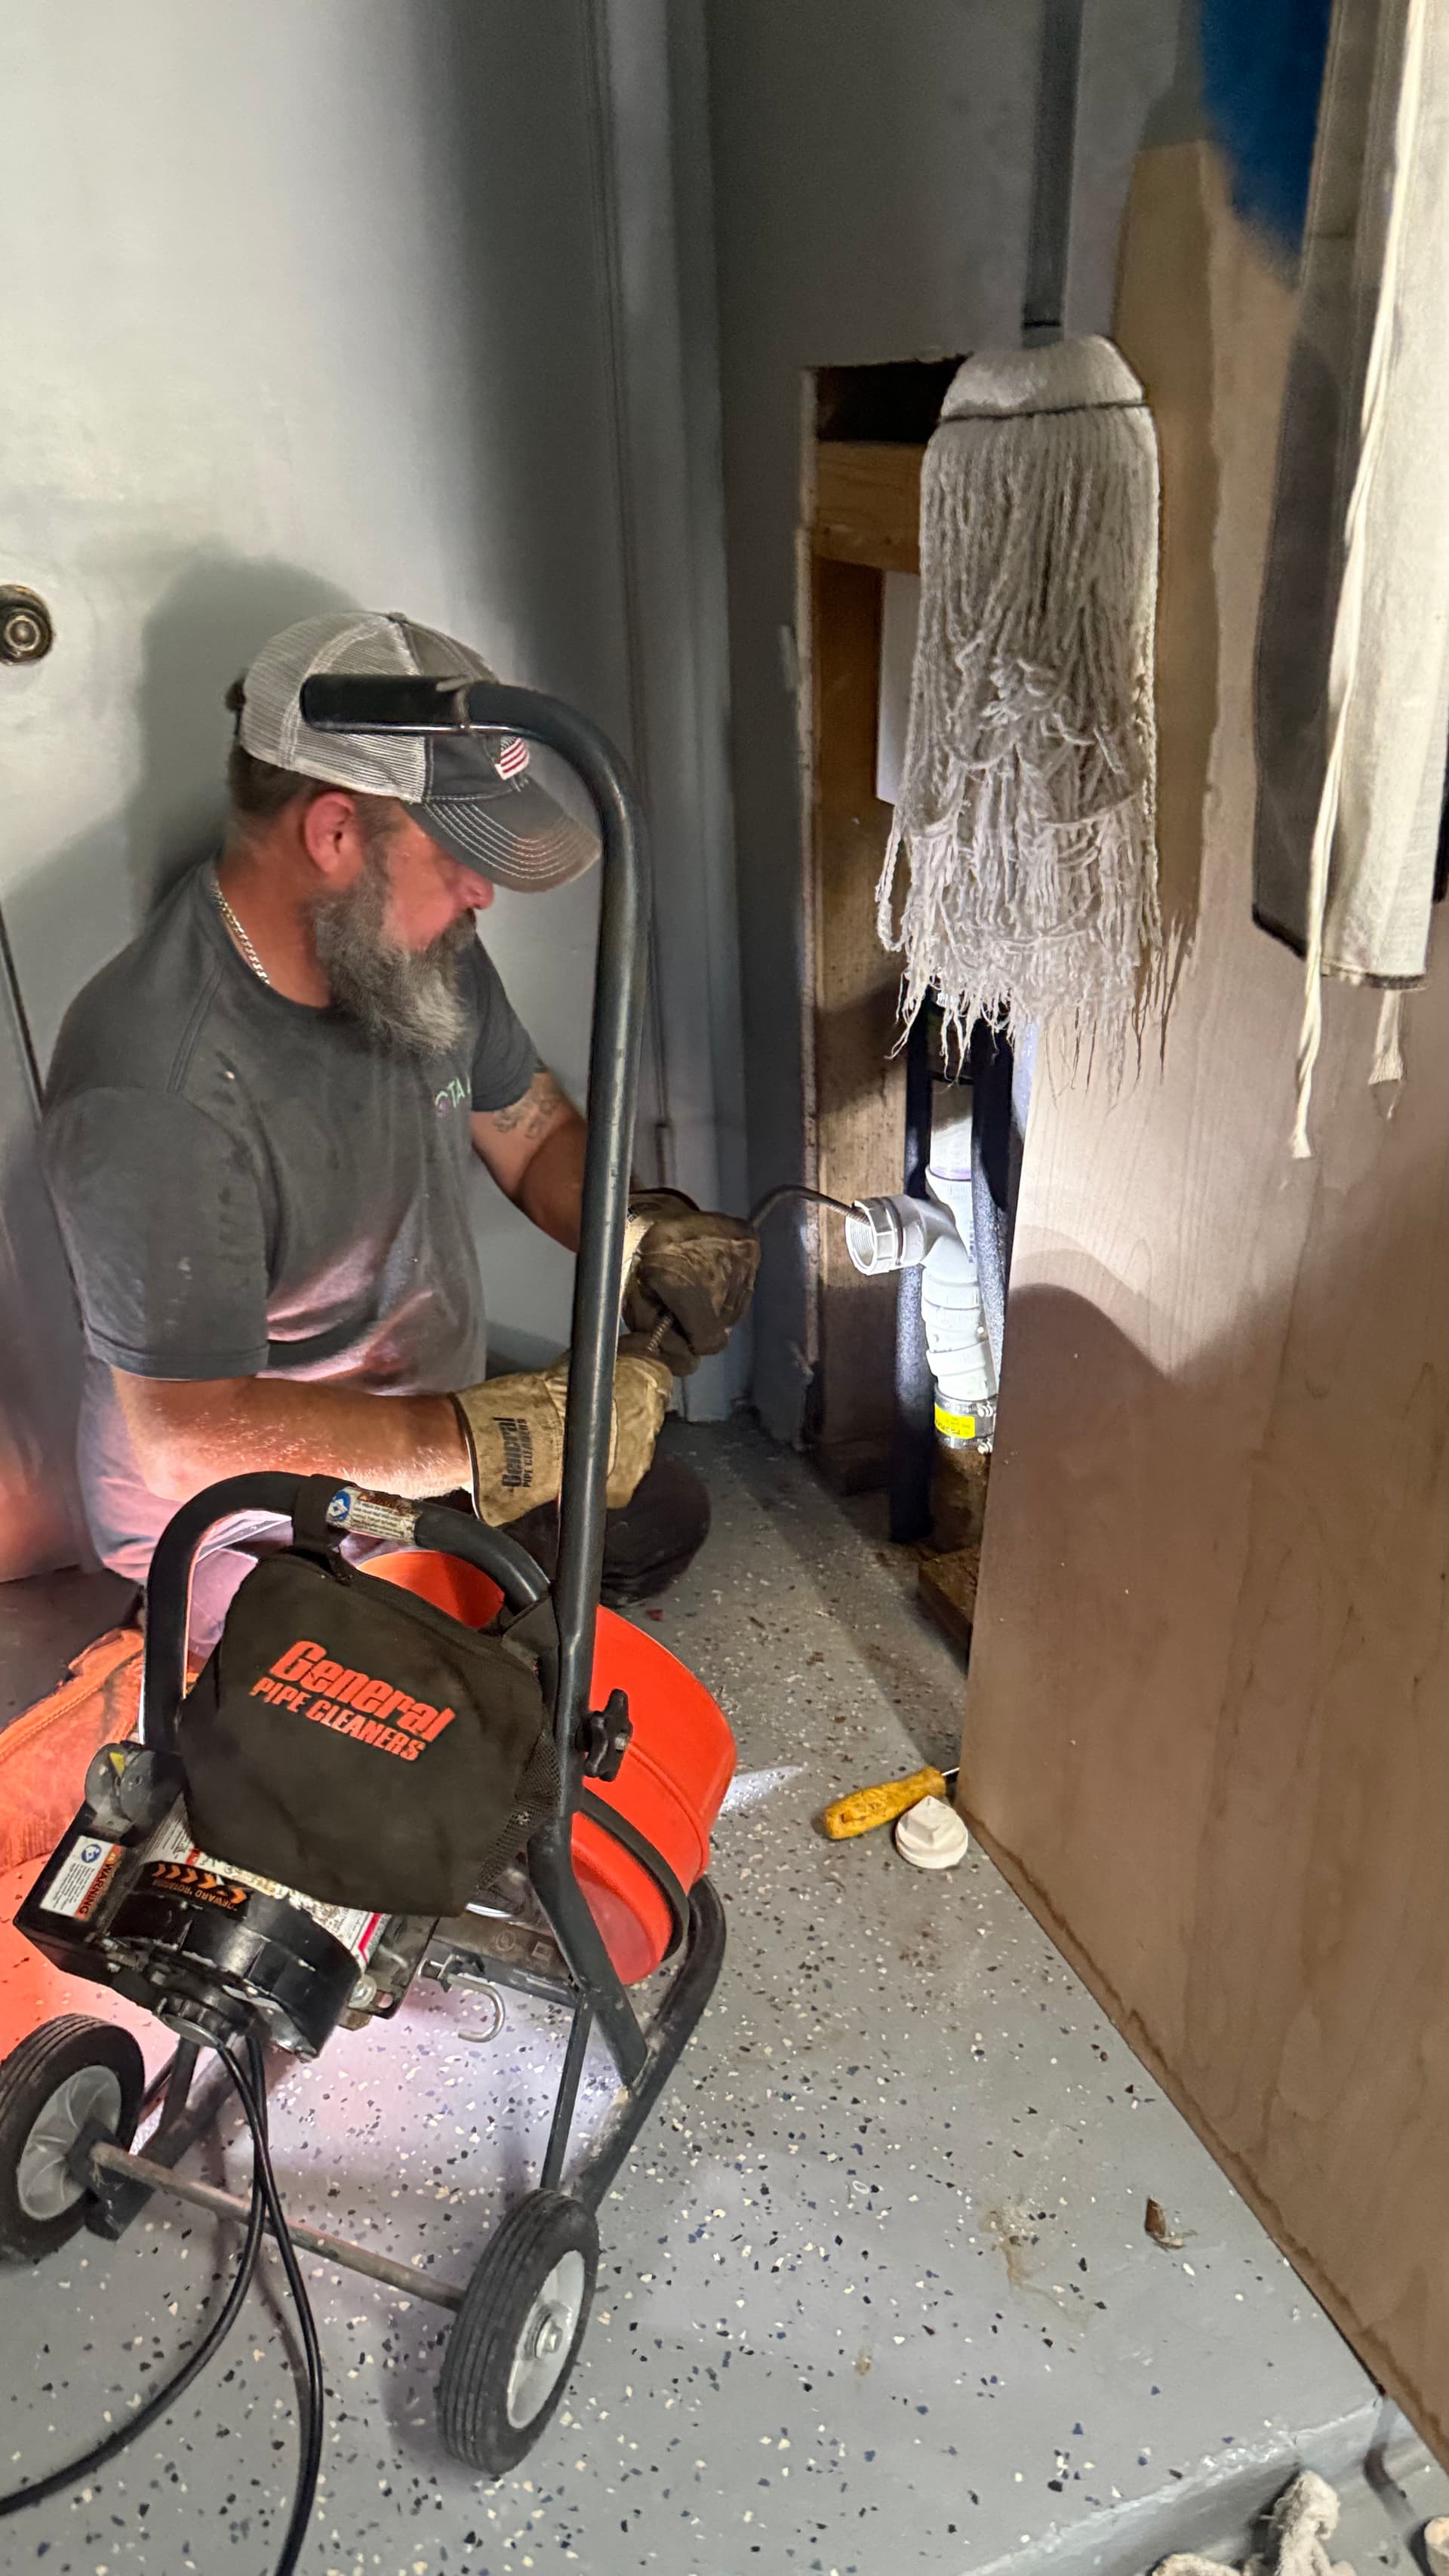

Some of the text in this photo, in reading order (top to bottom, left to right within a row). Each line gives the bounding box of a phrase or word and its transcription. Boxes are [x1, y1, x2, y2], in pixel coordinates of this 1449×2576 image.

[249, 1677, 426, 1761] PIPE CLEANERS
[269, 1640, 456, 1742] General
[79, 1864, 113, 1914] WARNING
